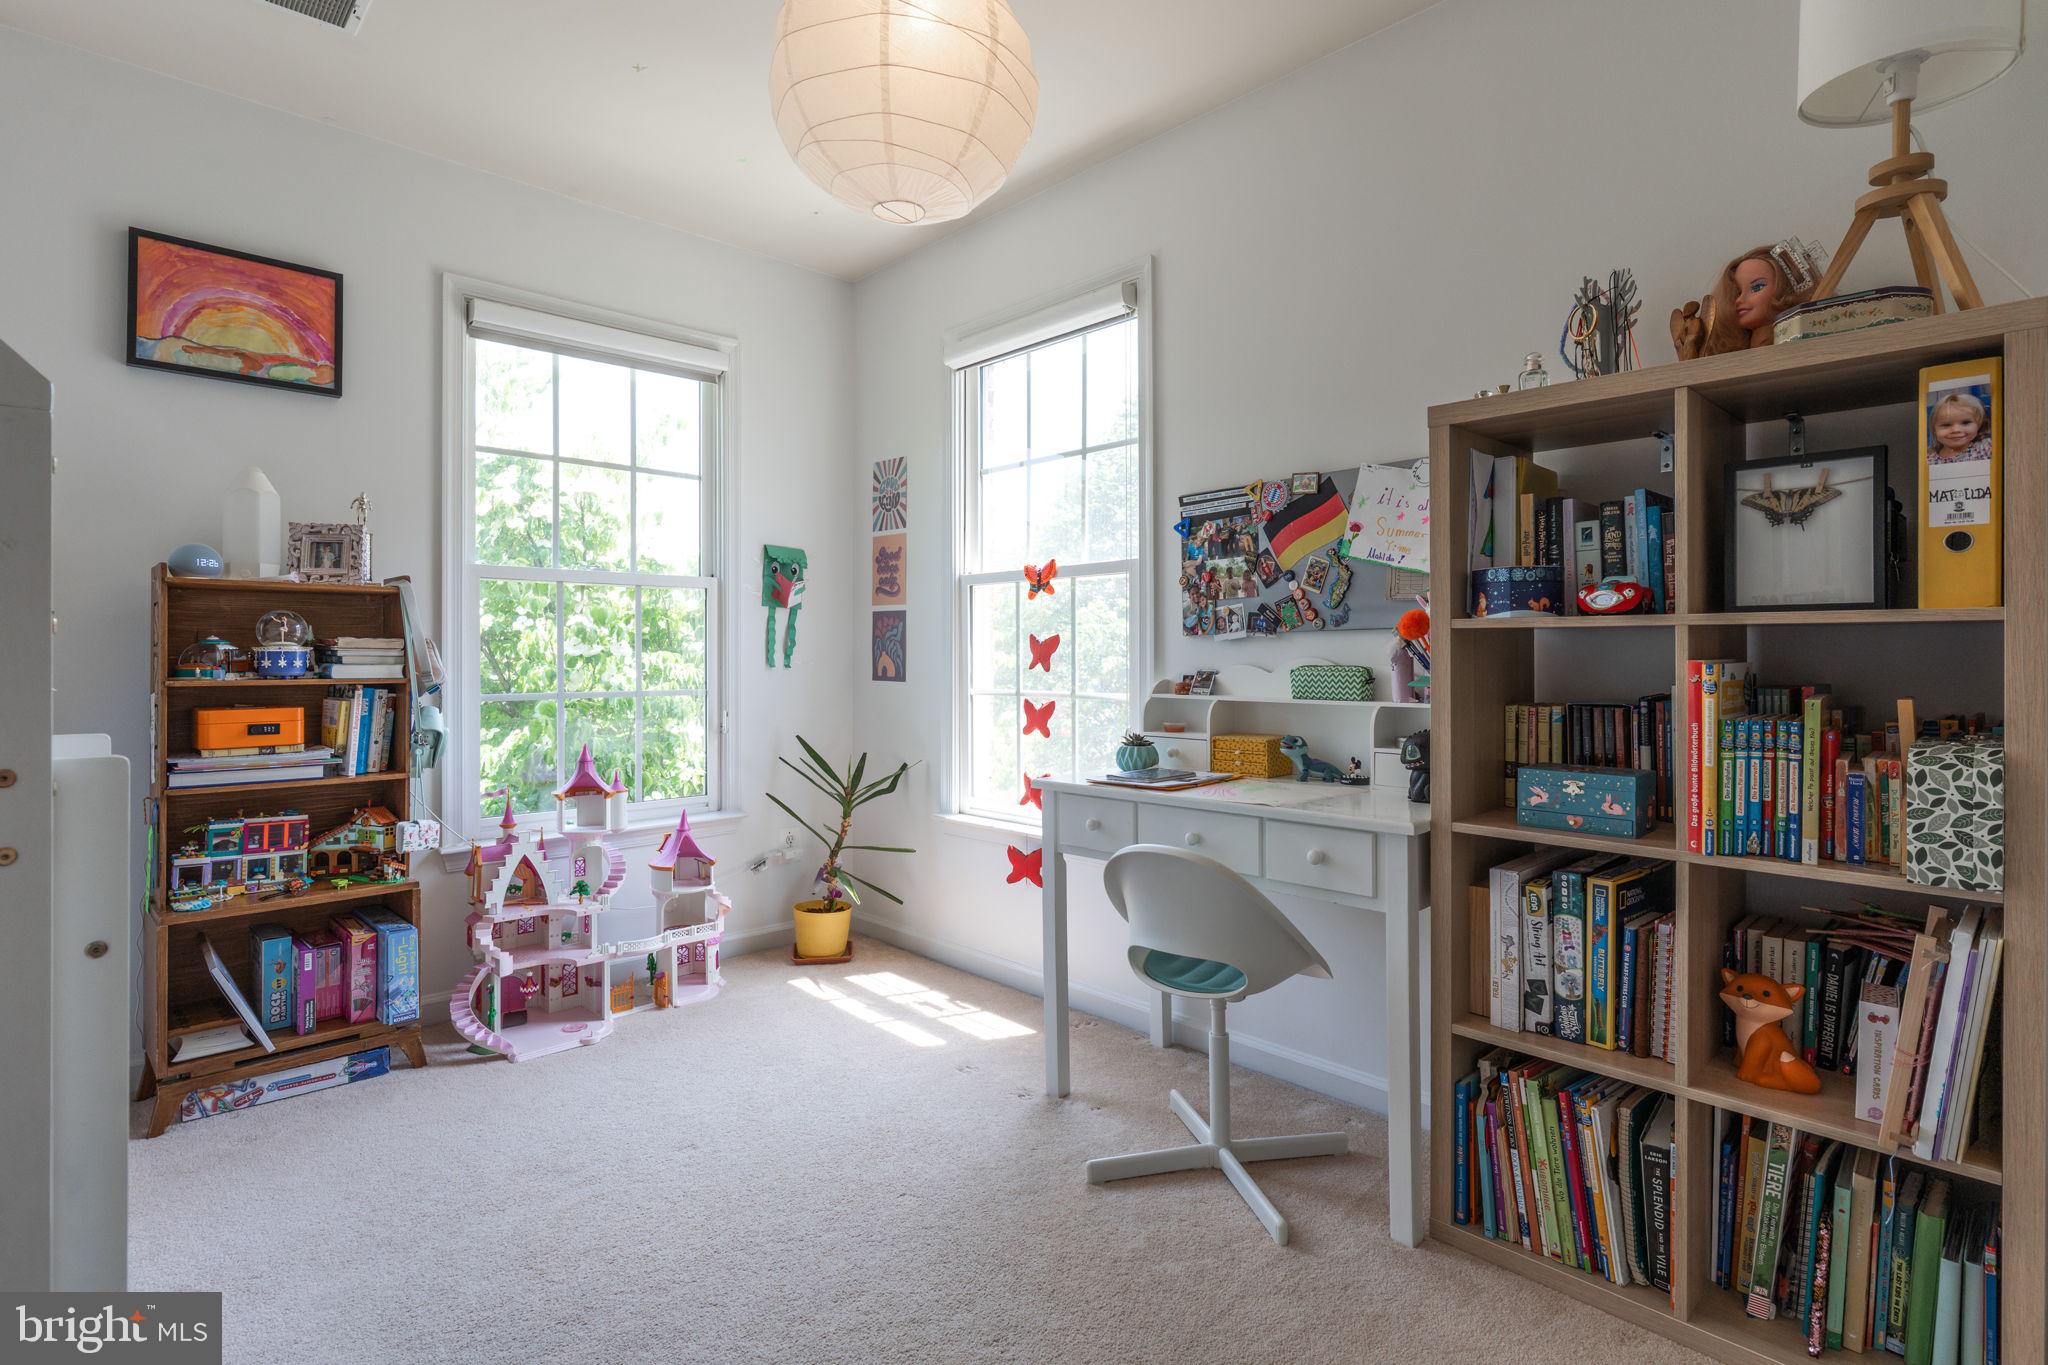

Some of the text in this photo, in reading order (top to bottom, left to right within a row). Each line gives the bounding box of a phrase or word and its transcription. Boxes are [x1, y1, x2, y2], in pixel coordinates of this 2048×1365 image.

[1665, 554, 1673, 566] Fang
[1666, 539, 1674, 553] White
[196, 558, 219, 568] 12:26
[1690, 722, 1699, 773] Bildwörterbuch
[1691, 774, 1699, 792] bunte
[1691, 794, 1699, 814] große
[1530, 893, 1538, 911] LENA
[1530, 920, 1546, 967] String Art
[1597, 948, 1605, 992] BUTTERFLY
[270, 992, 281, 1023] ROCK
[393, 1014, 416, 1023] KOSMOS
[1820, 973, 1840, 1059] DANIEL IS DIFFERENT
[1872, 1029, 1882, 1100] INSPIRATION CARDS
[1502, 1088, 1516, 1147] EYEWITNESS BOOKS
[1549, 1126, 1565, 1202] Wo die Tiere wohnen
[1644, 1156, 1668, 1164] LARSON
[1515, 1177, 1524, 1210] MINERALS
[1538, 1158, 1551, 1211] Животные
[1766, 1162, 1785, 1199] TIERE
[1652, 1178, 1664, 1230] SPLENDID
[1772, 1202, 1780, 1214] Die
[1758, 1201, 1772, 1265] spektakulären Bildern
[1769, 1215, 1778, 1240] Tierwelt
[1657, 1254, 1667, 1277] VILE
[1893, 1307, 1901, 1324] EARTH
